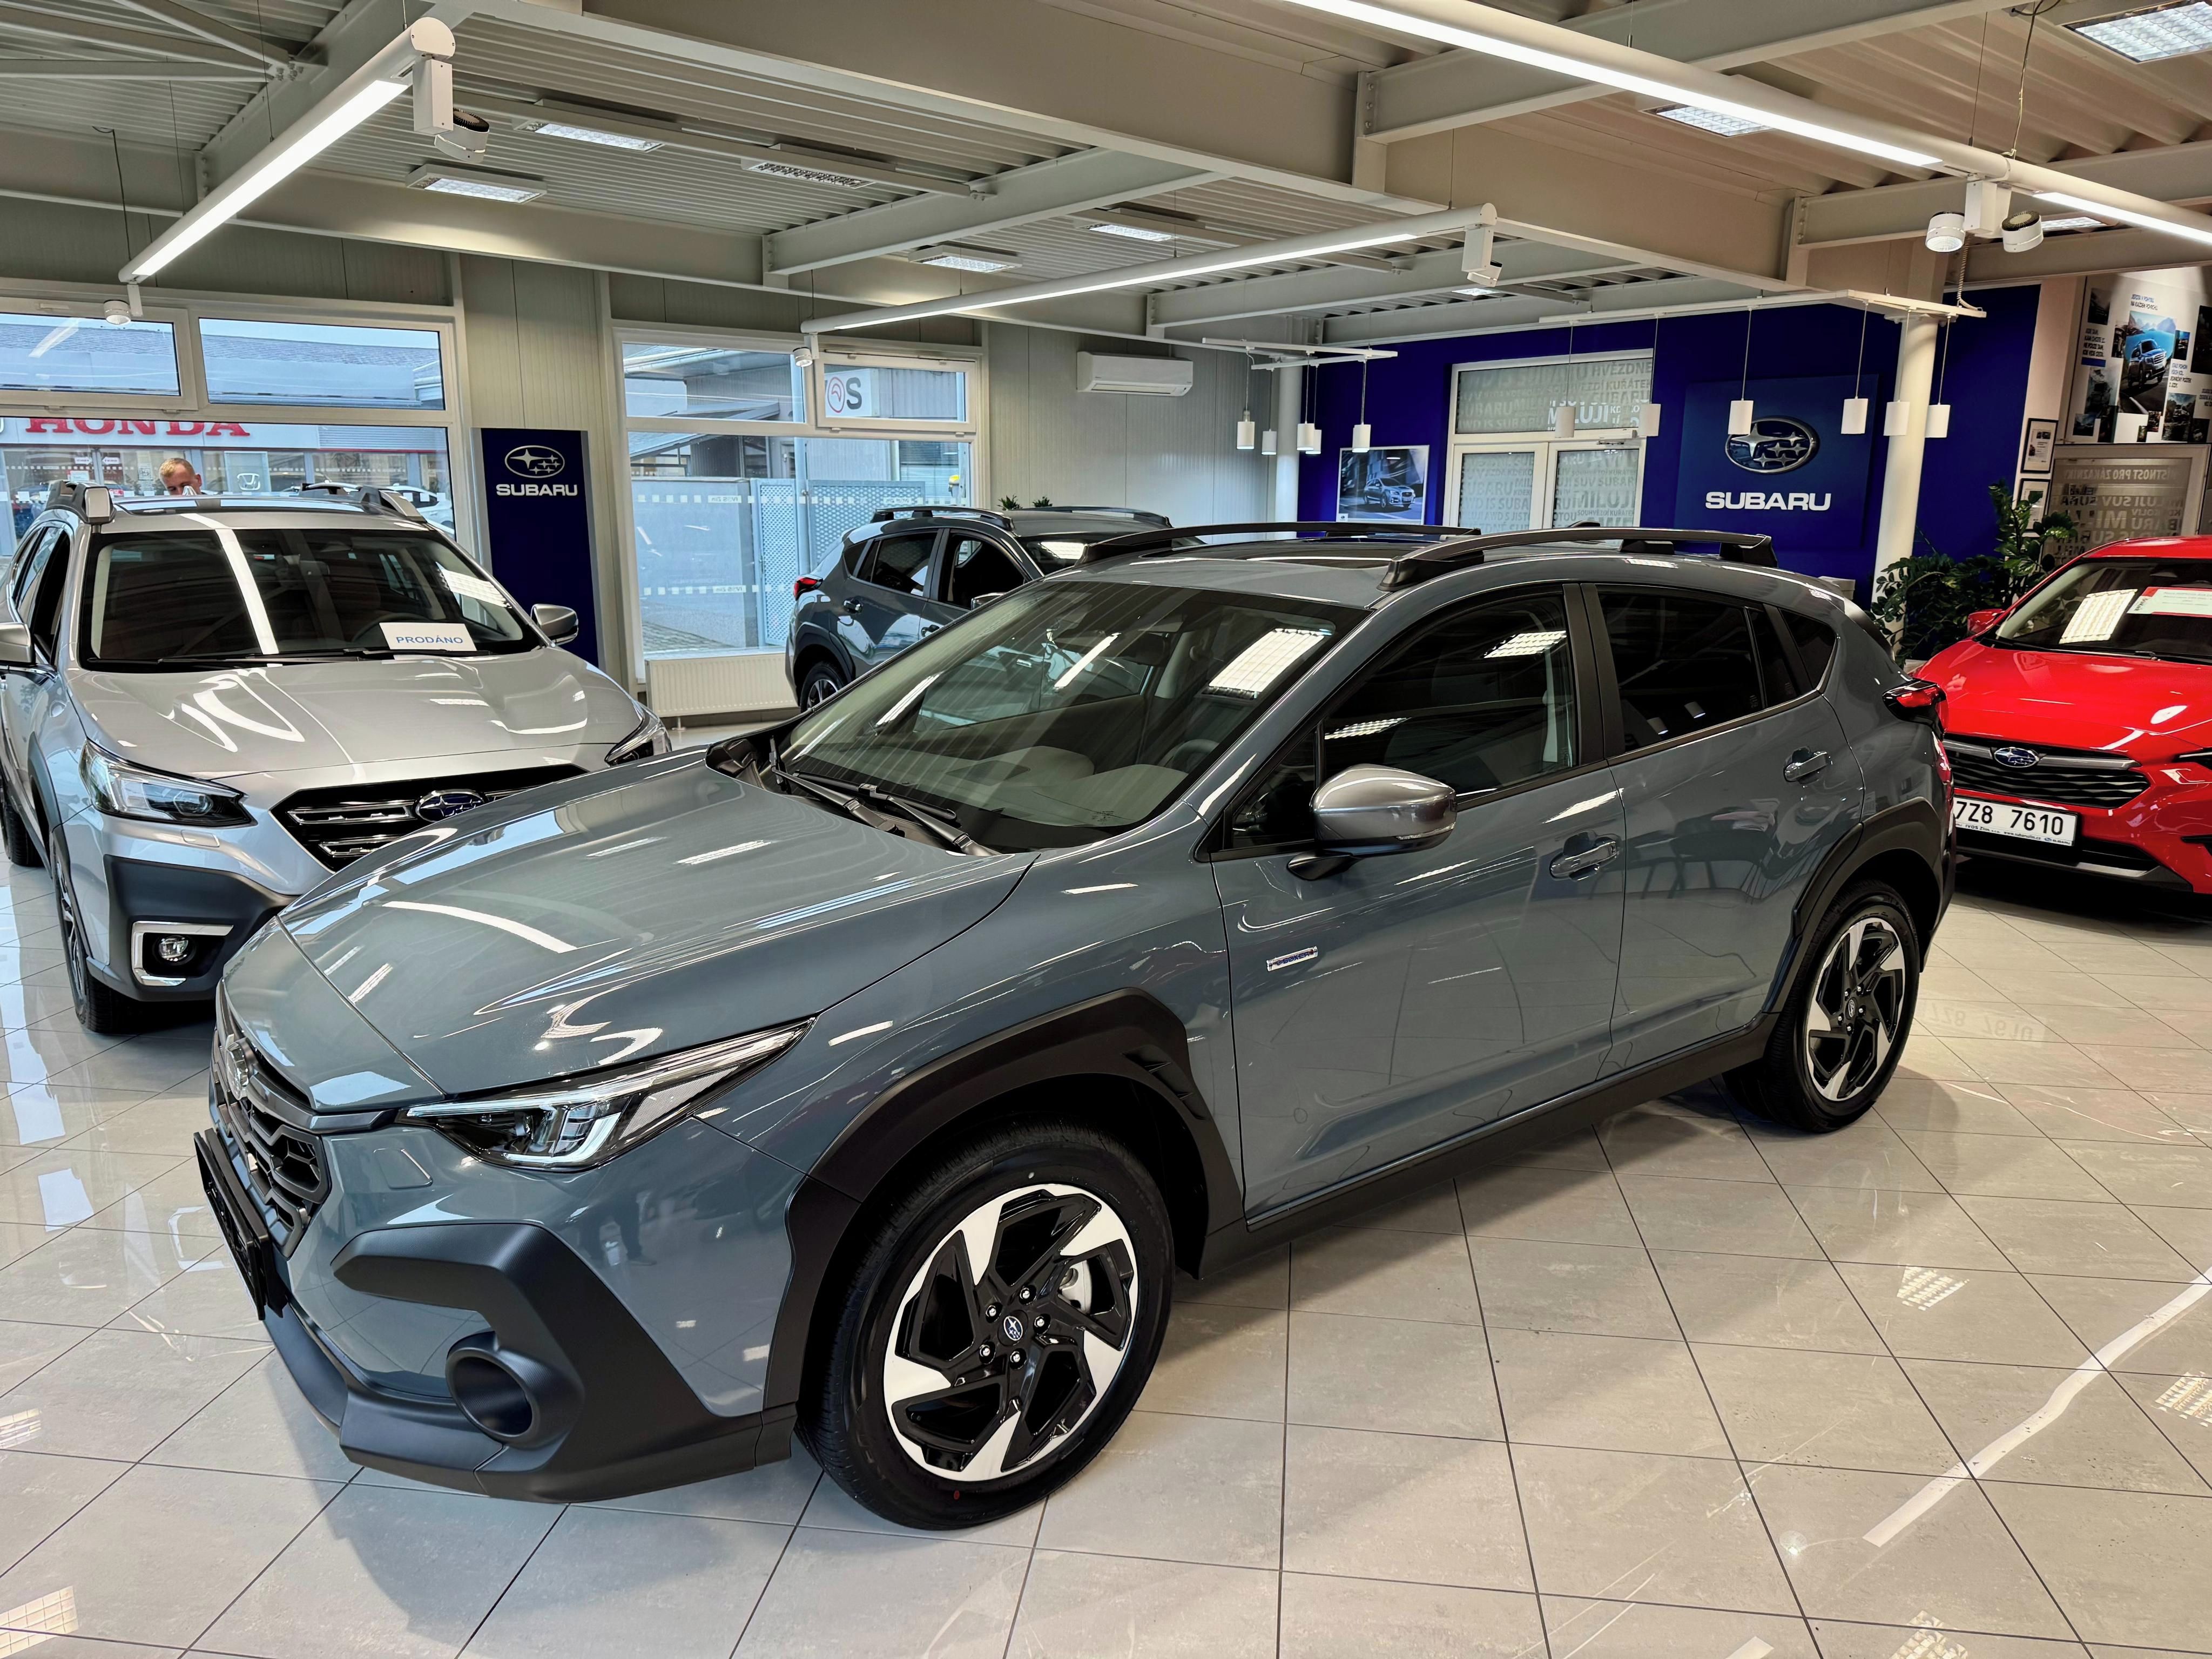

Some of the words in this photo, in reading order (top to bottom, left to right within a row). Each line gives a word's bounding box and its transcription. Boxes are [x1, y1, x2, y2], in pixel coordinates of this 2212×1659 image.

[496, 484, 578, 496] SUBARU
[1705, 491, 1831, 511] SUBARU
[396, 634, 463, 645] PRODÁNO
[1954, 800, 1993, 825] 7Z8
[2009, 808, 2063, 836] 7610
[1277, 952, 1310, 966] e-BOXER
